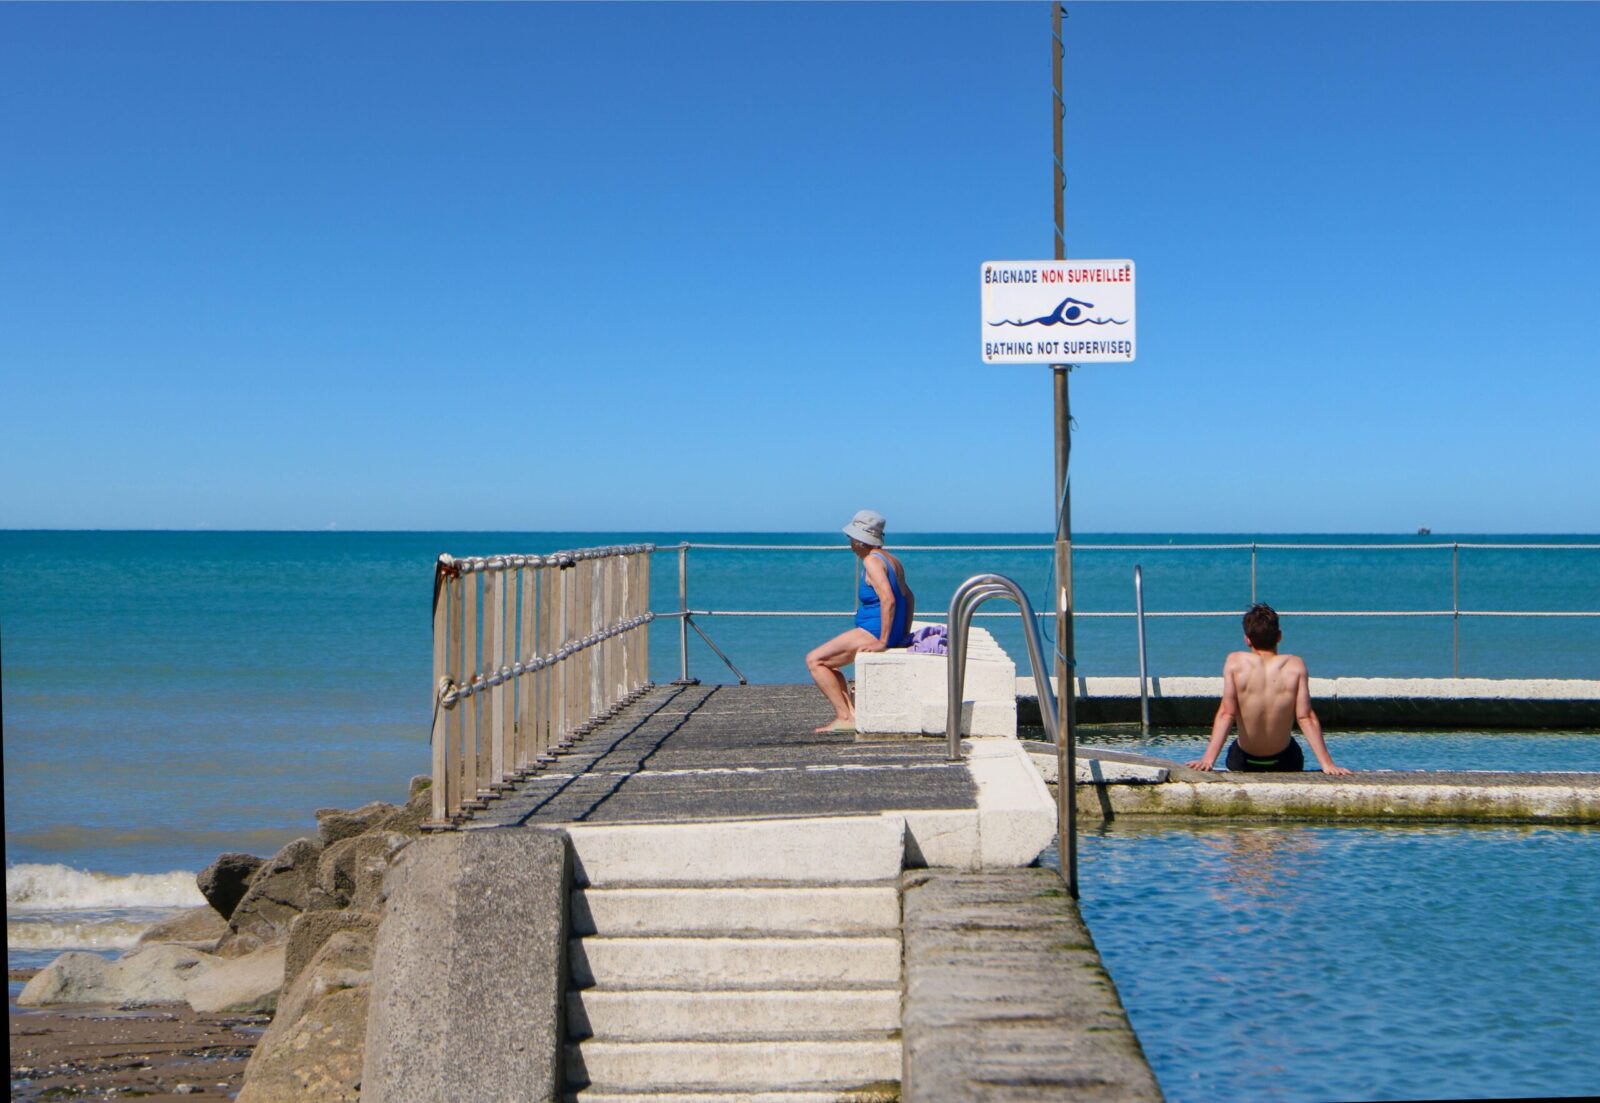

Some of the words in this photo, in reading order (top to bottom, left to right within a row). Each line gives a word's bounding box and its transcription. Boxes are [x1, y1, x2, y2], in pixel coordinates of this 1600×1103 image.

[985, 269, 1037, 284] BAIGNADE
[1042, 269, 1064, 283] NON
[1068, 268, 1131, 283] SURVEILLEE
[986, 342, 1033, 356] BATHING
[1038, 341, 1060, 355] NOT
[1063, 340, 1132, 354] SUPERVISED
